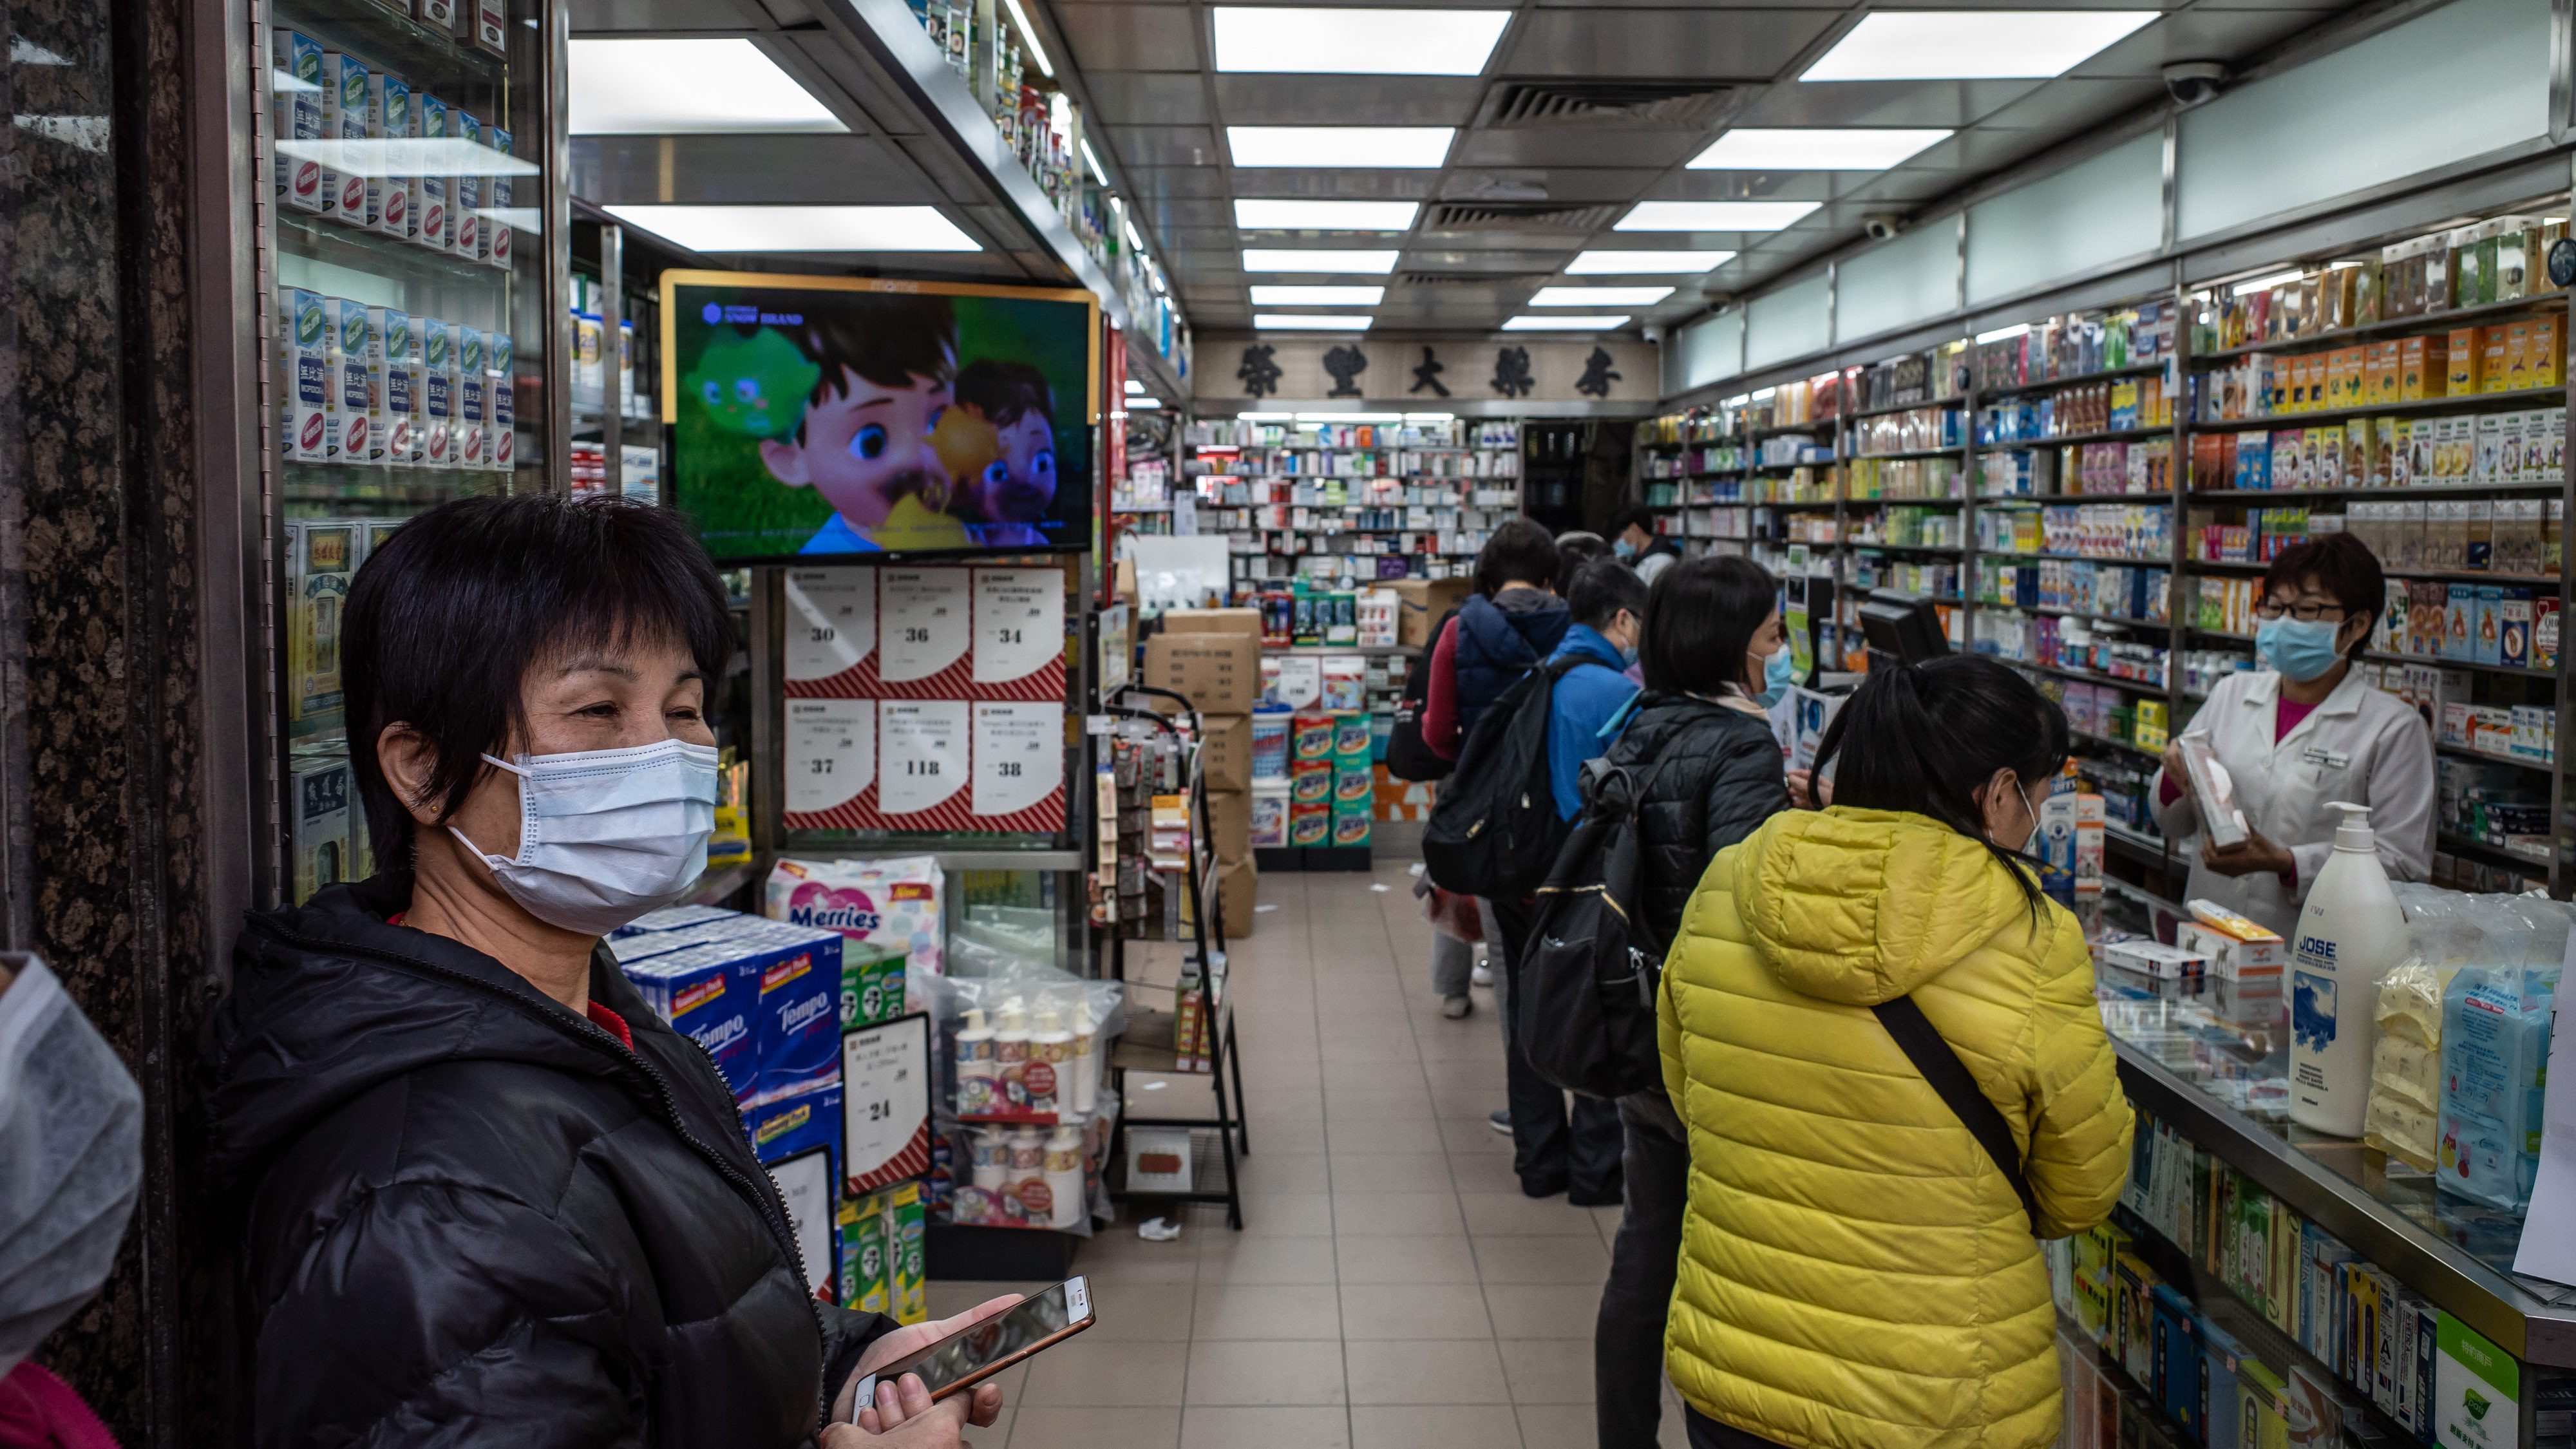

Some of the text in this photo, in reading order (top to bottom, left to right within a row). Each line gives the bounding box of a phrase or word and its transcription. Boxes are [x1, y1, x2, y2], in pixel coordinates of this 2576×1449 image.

[811, 628, 834, 643] 30
[905, 627, 929, 643] 36
[999, 629, 1021, 644] 34
[811, 759, 833, 773] 37
[907, 760, 940, 775] 118
[999, 762, 1021, 777] 38
[791, 906, 882, 929] Merries
[2299, 935, 2336, 958] JOSE
[776, 992, 828, 1032] Tempo
[689, 1014, 744, 1050] Tempo
[869, 1099, 891, 1121] 24
